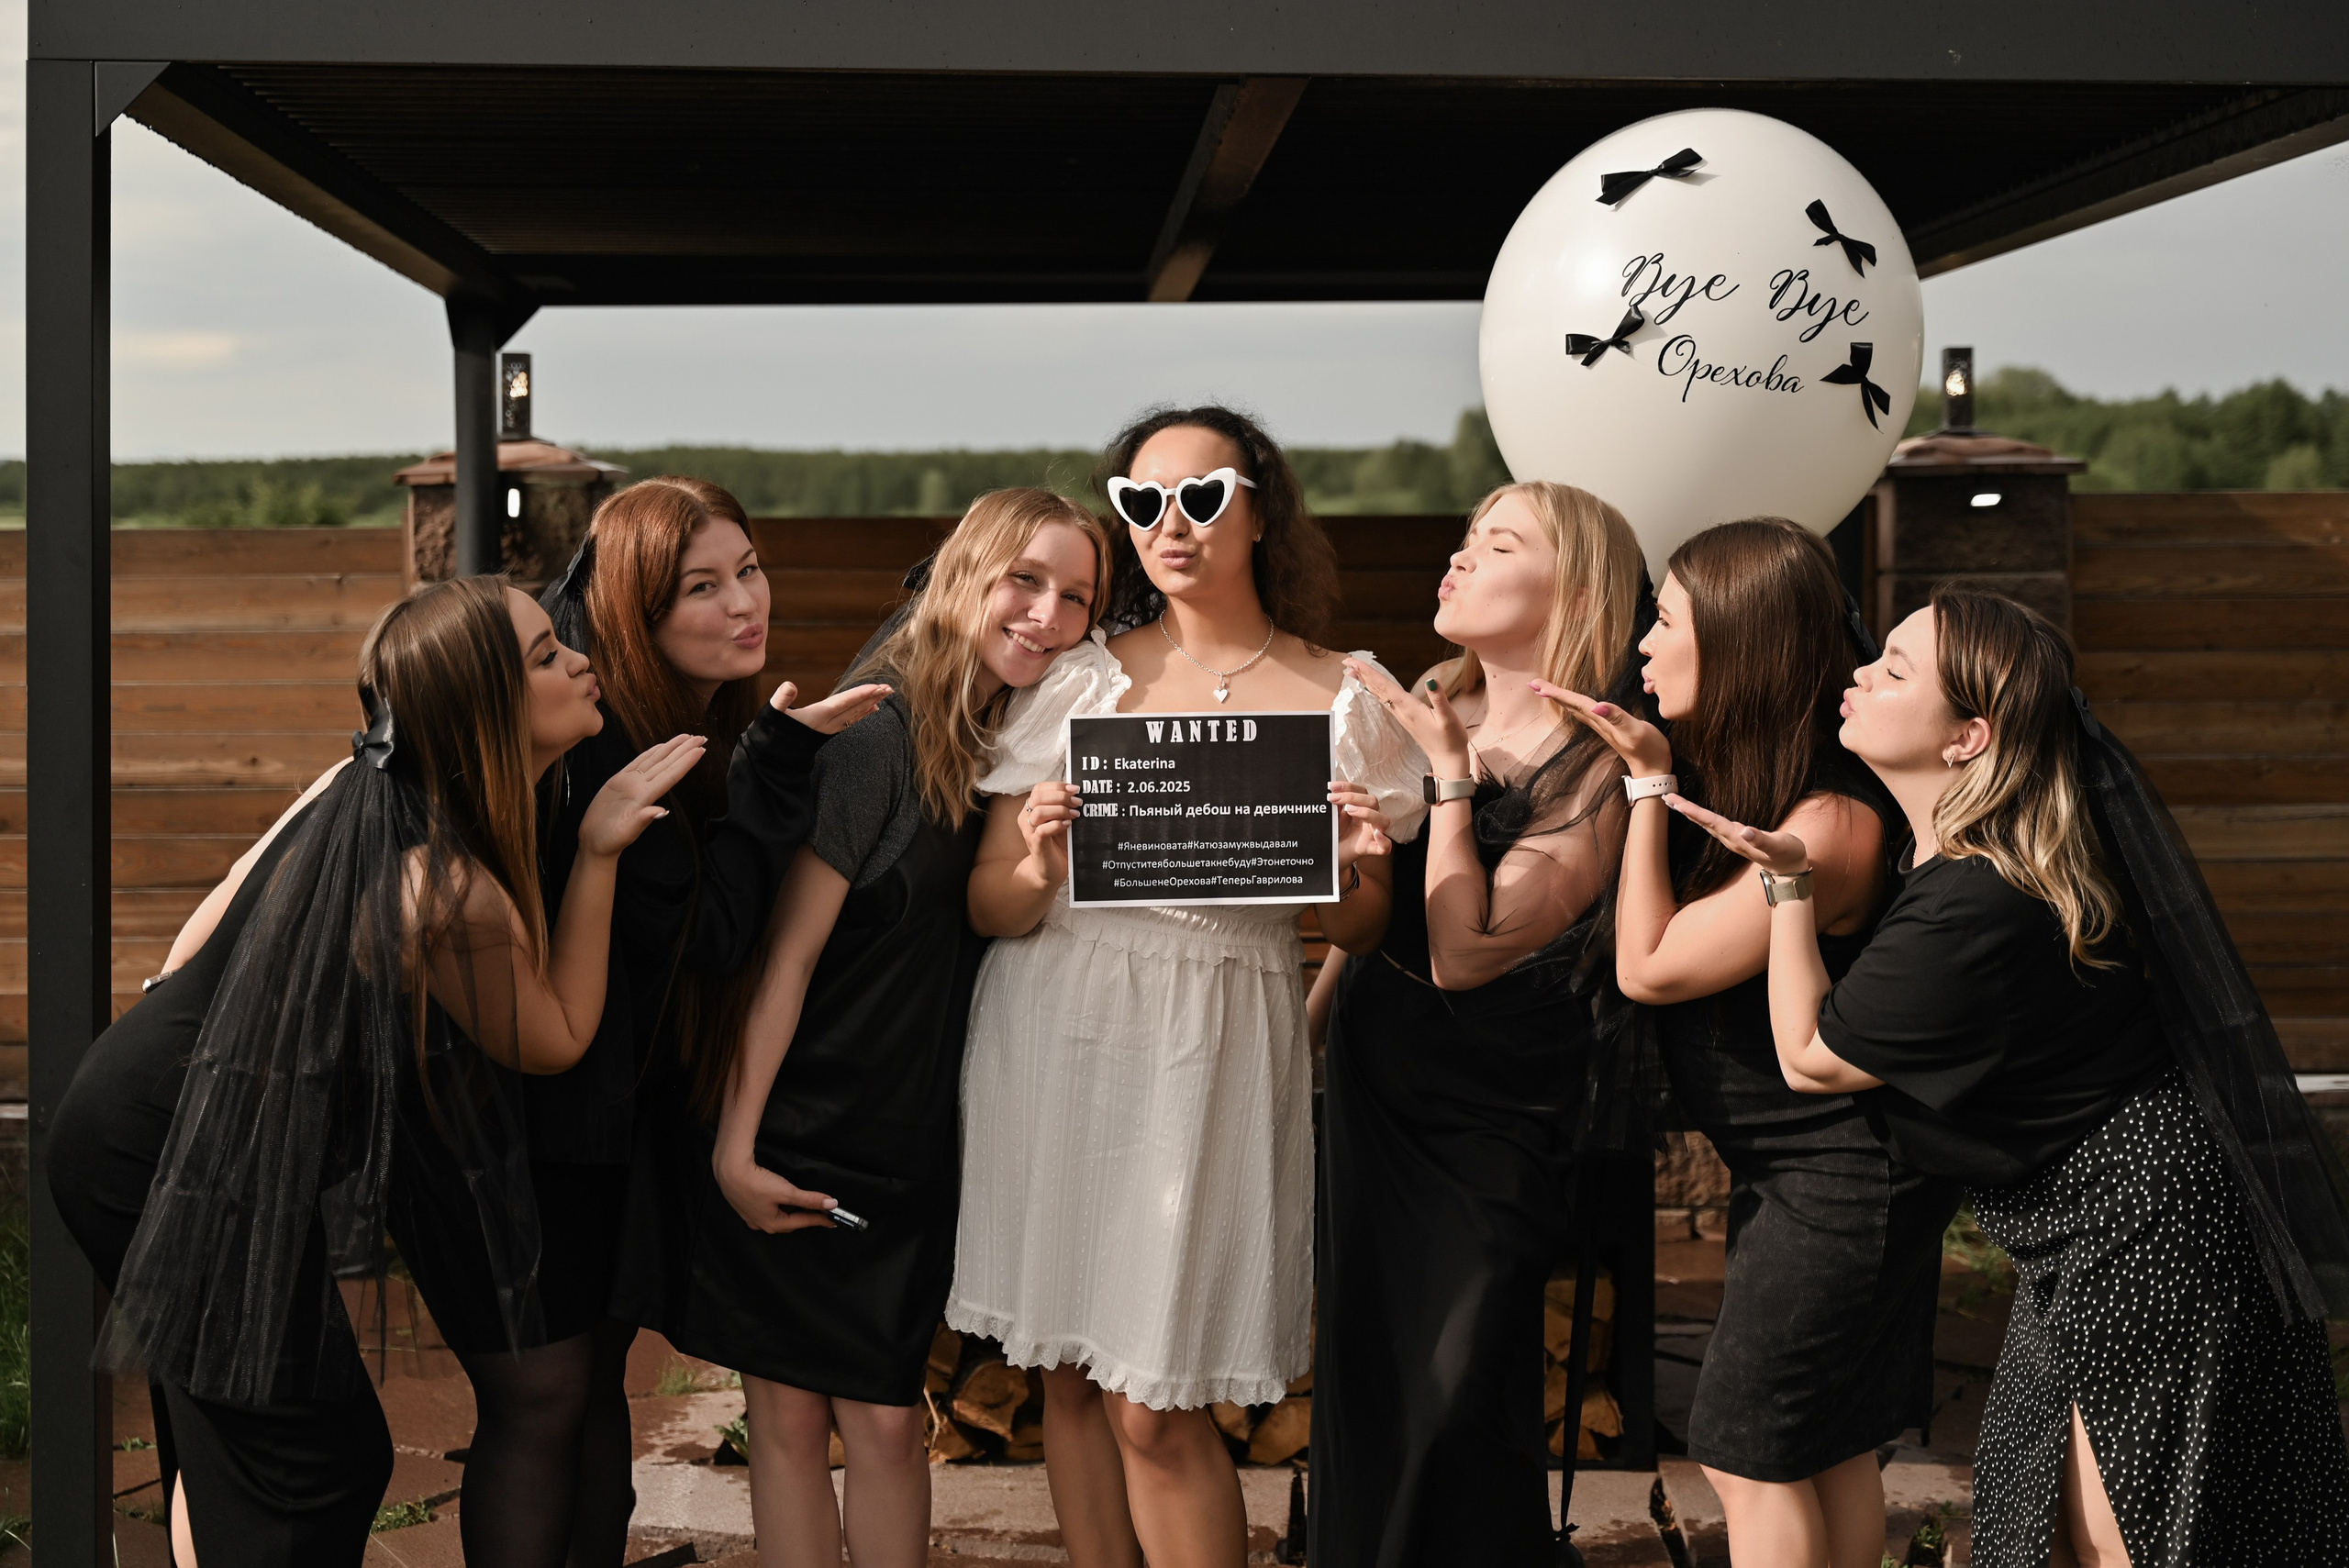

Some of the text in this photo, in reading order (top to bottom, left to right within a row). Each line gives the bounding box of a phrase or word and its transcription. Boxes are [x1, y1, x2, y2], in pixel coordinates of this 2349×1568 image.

[1621, 252, 1869, 342] Bye Bye
[1657, 334, 1805, 402] Орехова
[1145, 719, 1257, 744] WANTED
[1114, 757, 1175, 770] Ekaterina
[1127, 781, 1191, 794] 2.06.2025
[1129, 804, 1183, 817] Пьяный
[1185, 803, 1231, 818] дебош
[1234, 805, 1251, 815] на
[1253, 804, 1328, 817] девичнике
